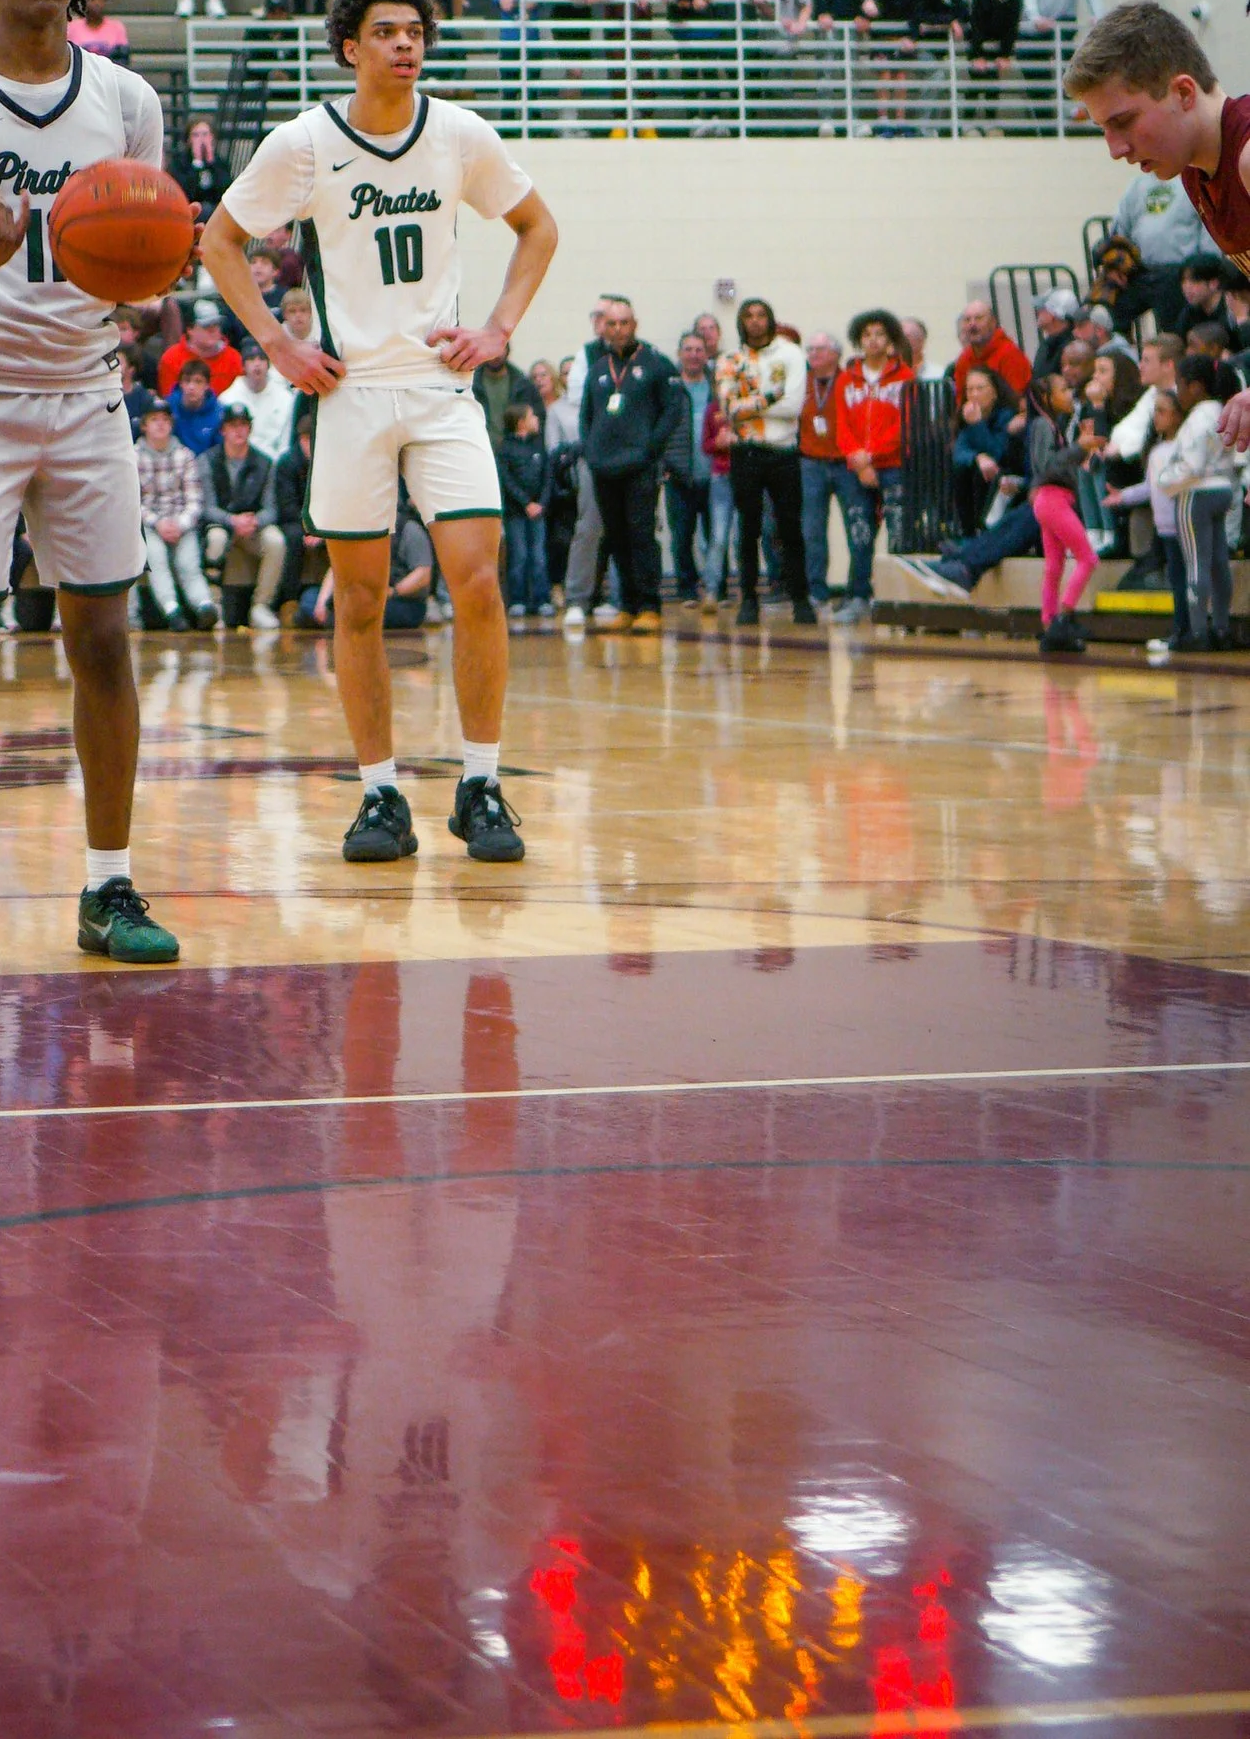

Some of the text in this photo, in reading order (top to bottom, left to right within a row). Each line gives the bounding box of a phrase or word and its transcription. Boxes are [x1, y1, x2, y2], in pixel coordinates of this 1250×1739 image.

[349, 183, 441, 220] Pirates
[26, 209, 67, 283] 1
[374, 224, 423, 285] 10
